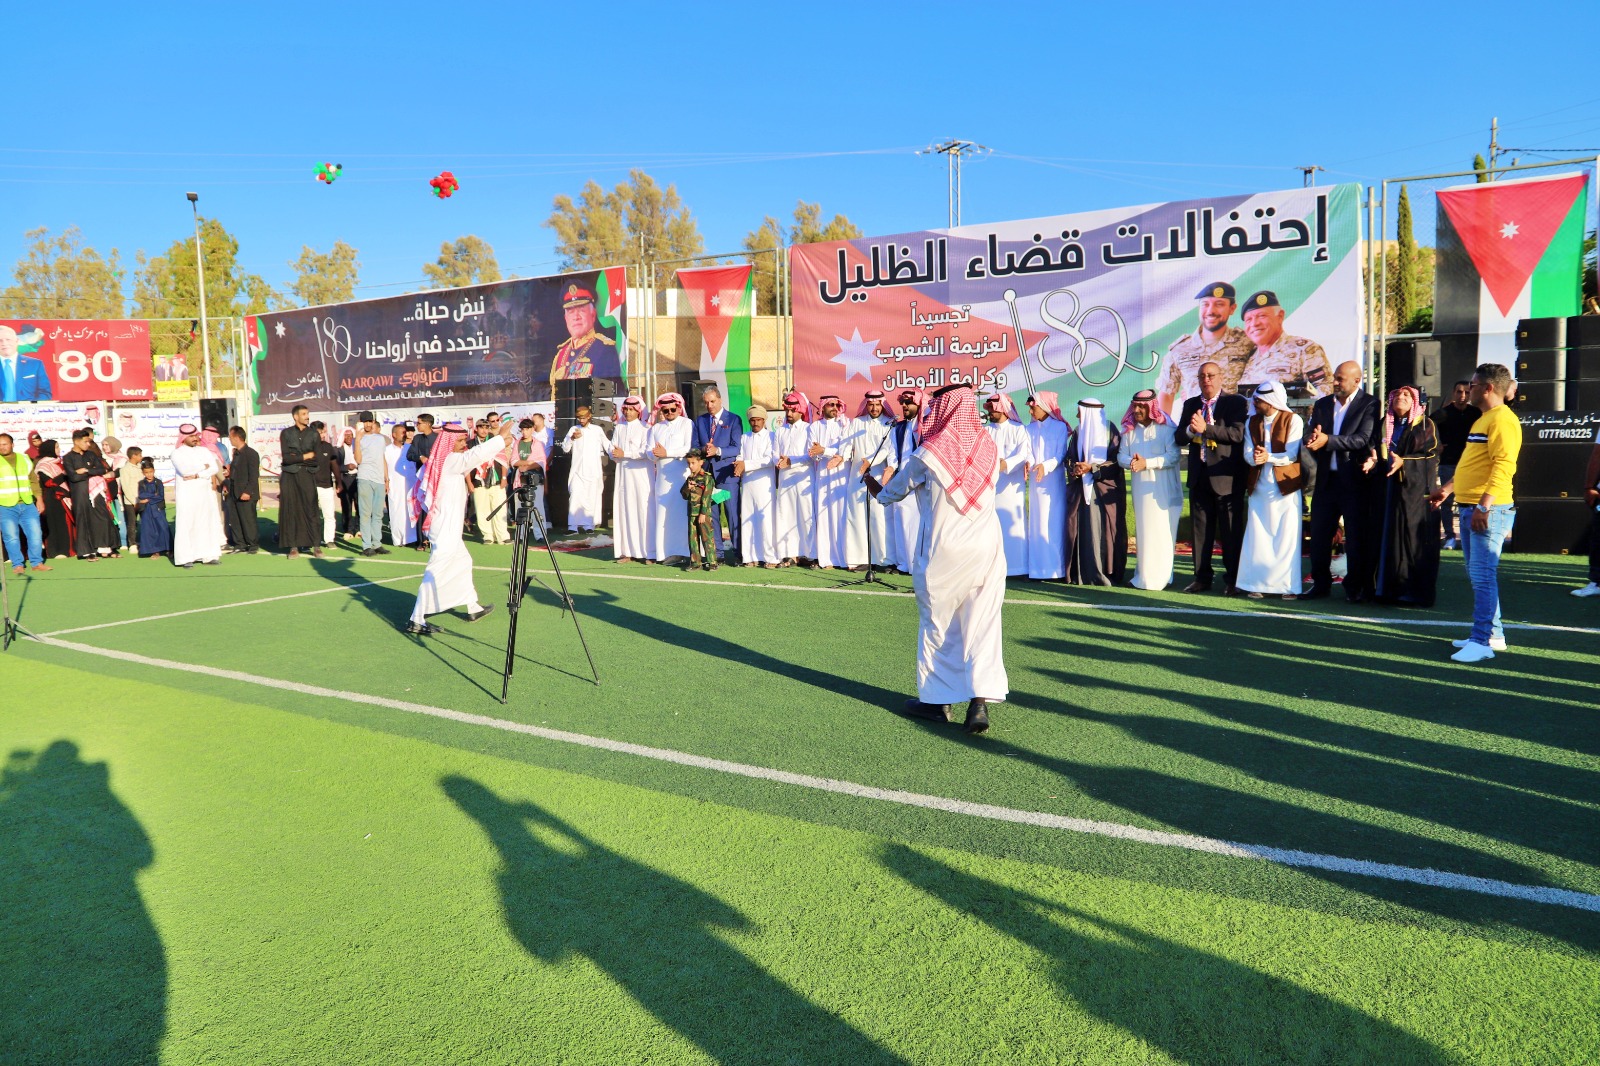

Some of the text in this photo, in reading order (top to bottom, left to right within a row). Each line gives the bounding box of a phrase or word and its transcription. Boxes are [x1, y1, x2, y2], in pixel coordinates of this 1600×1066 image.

[819, 195, 1329, 304] إحتفالات قضاء الظليل
[453, 295, 485, 323] نبض
[96, 330, 108, 341] دام
[366, 331, 490, 363] يتجدد في أرواحنا
[876, 333, 1007, 364] لعزيمة الشعوب
[58, 350, 122, 383] 80
[883, 366, 1007, 391] وكرامة الأوطان
[122, 388, 148, 396] berry
[340, 375, 394, 390] ALARQAWI
[265, 388, 324, 405] الاستقلال
[1539, 428, 1592, 439] 0777803225
